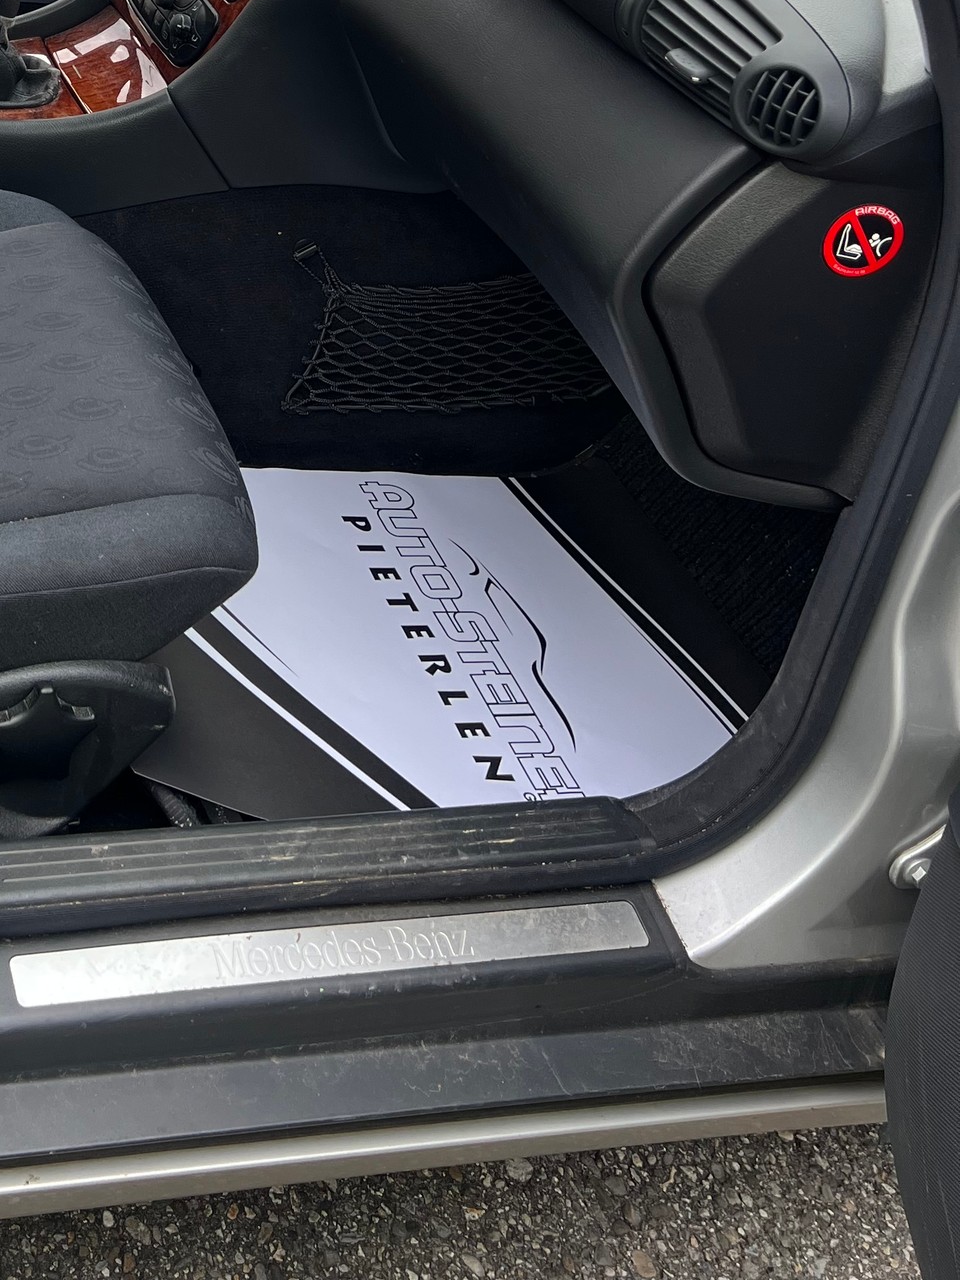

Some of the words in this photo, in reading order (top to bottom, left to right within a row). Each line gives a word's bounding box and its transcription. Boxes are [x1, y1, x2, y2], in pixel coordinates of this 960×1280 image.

[855, 206, 900, 225] AIRBAG
[341, 515, 516, 783] PIETERLEN
[208, 925, 476, 981] Mercedes-Benz
